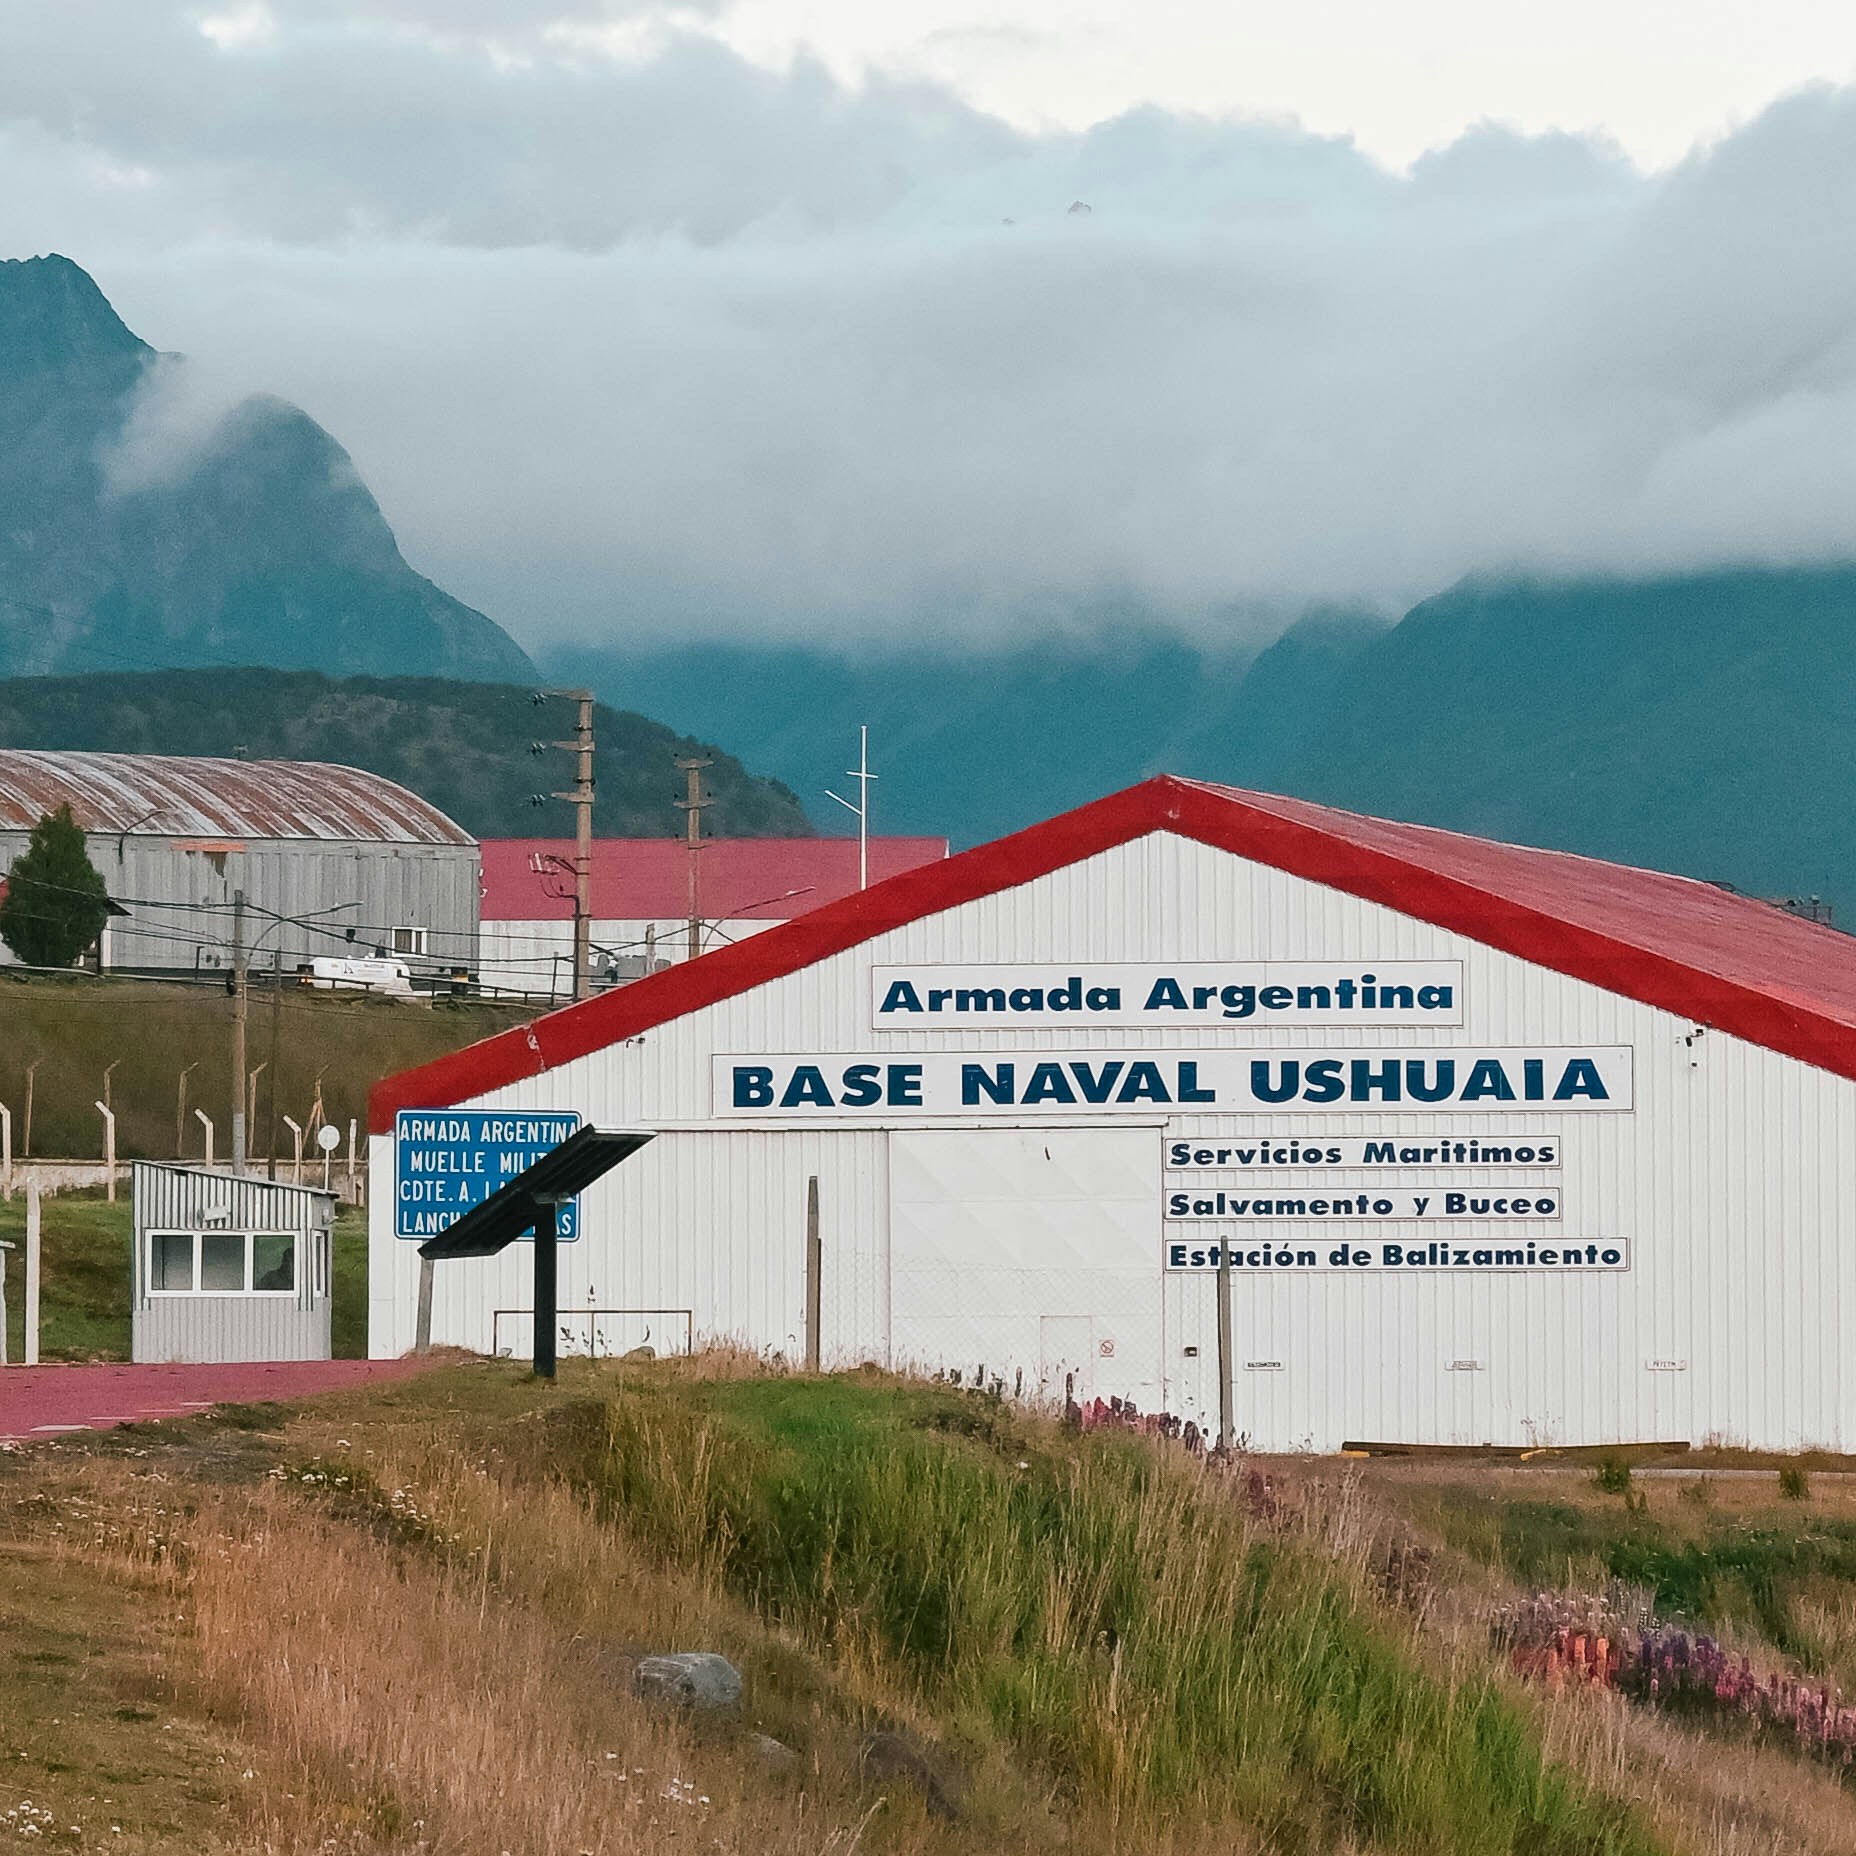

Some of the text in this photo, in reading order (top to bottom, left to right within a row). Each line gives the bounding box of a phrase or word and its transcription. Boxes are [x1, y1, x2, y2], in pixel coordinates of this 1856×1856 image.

[878, 973, 1454, 1019] Armada Argentina
[731, 1058, 1611, 1108] BASE NAVAL USHUAIA
[399, 1119, 578, 1144] ARMADA ARGENTINA
[410, 1150, 486, 1173] MUELLE
[1170, 1139, 1555, 1165] Servicios Maritimos
[399, 1179, 454, 1202] CDTE.
[1169, 1193, 1556, 1216] Salvamento y Buceo
[1170, 1241, 1622, 1267] Estación de Balizamiento
